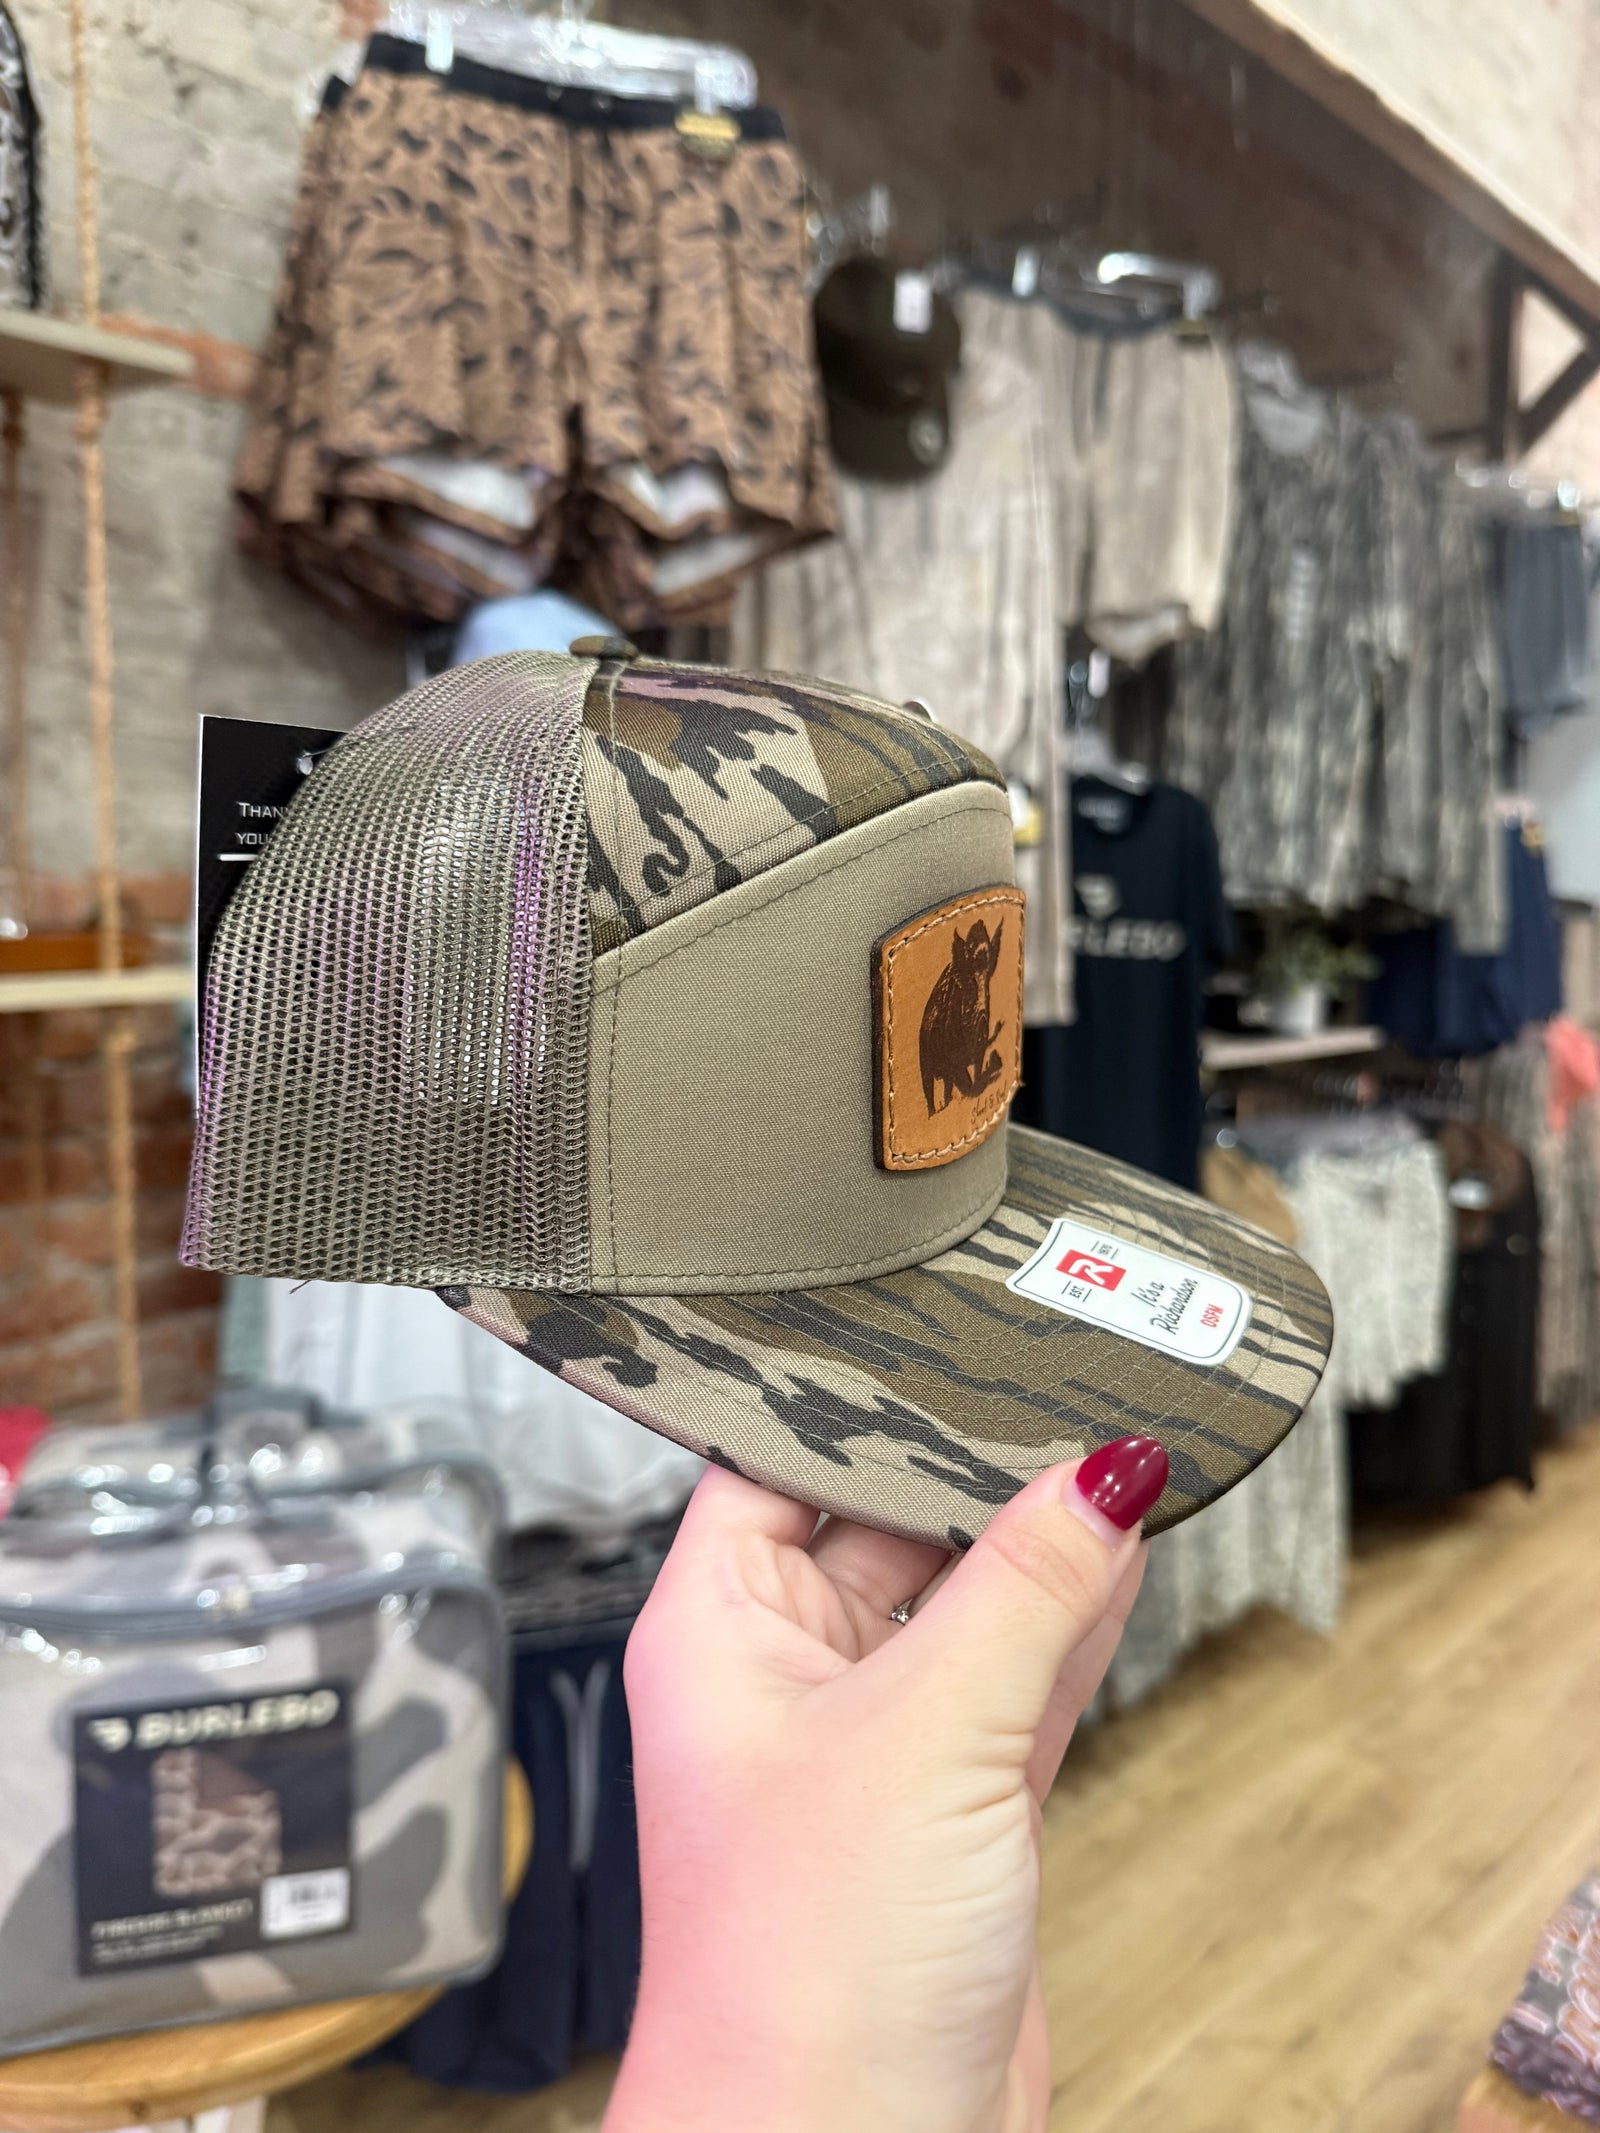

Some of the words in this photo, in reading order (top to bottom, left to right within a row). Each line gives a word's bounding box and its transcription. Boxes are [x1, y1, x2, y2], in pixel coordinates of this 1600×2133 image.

[236, 801, 289, 819] THAN
[1069, 1285, 1085, 1299] EST.
[1130, 1286, 1161, 1308] It's
[1150, 1277, 1199, 1335] Richardson
[1200, 1303, 1225, 1328] OSFM
